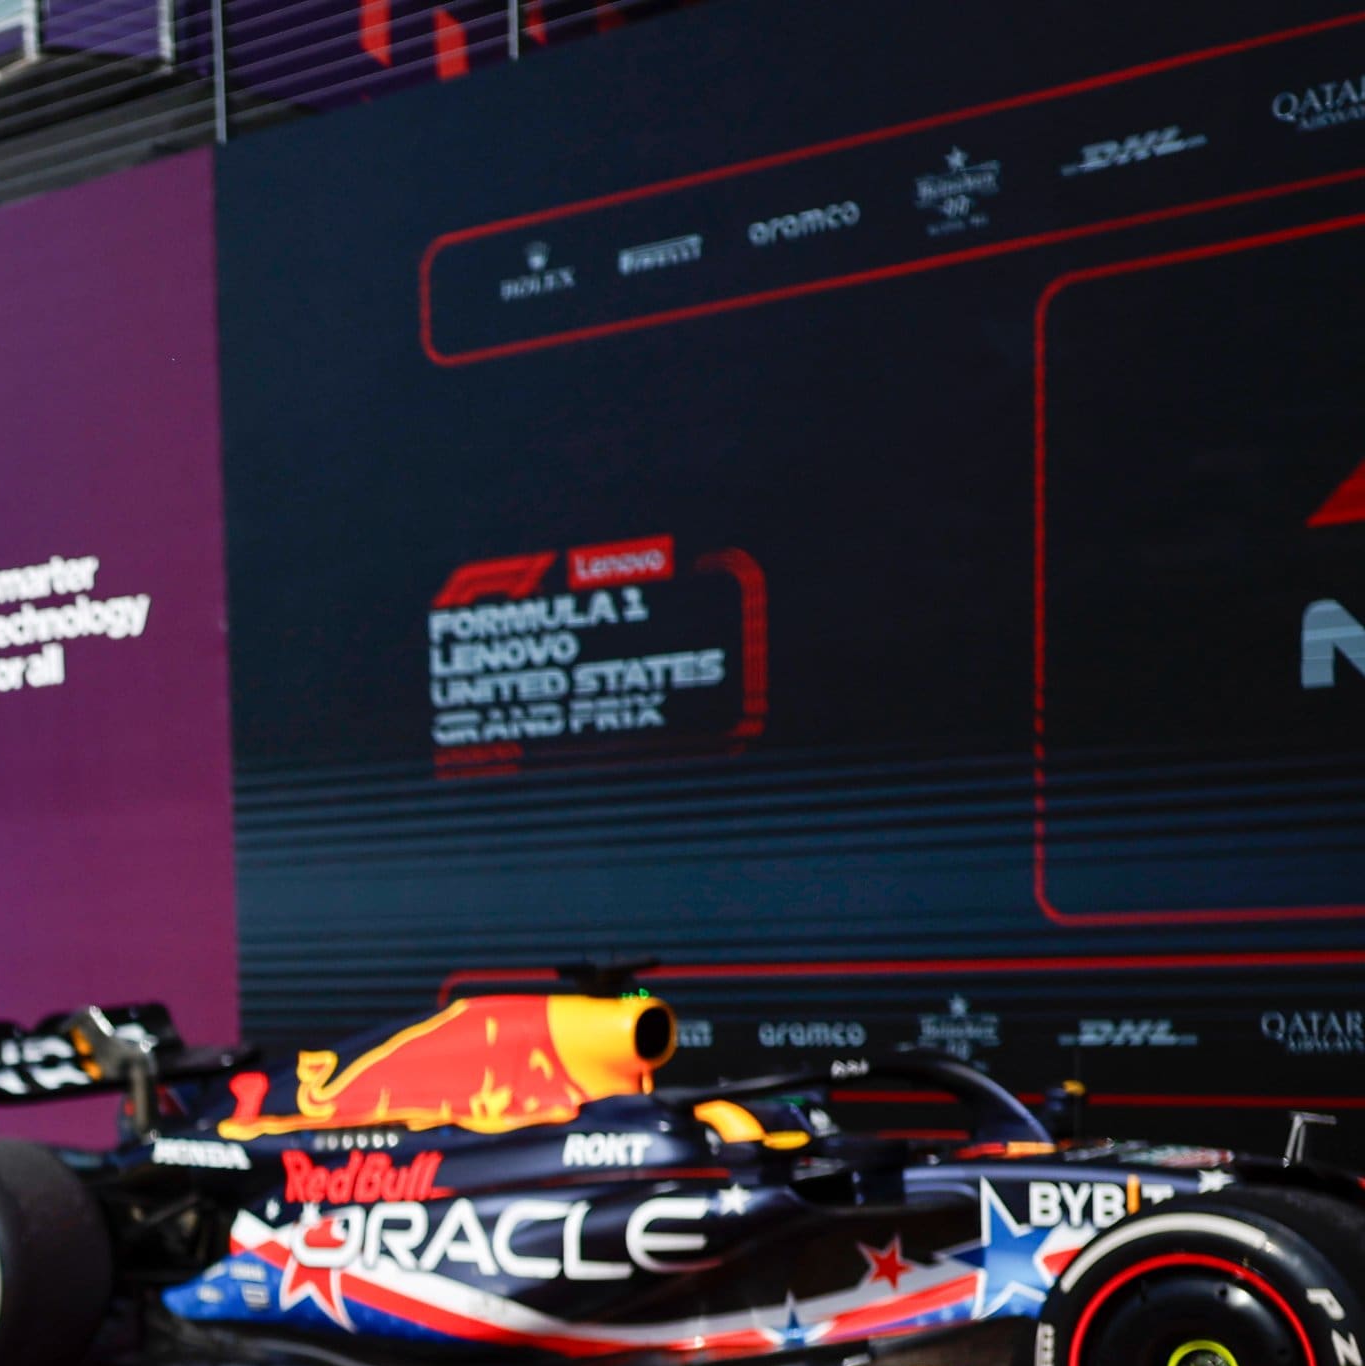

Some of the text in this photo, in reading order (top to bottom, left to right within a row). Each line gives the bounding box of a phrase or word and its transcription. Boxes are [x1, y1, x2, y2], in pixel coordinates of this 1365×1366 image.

[748, 200, 861, 246] aramco
[576, 550, 665, 580] Lenovo
[429, 586, 649, 642] FORMULA 1
[25, 643, 65, 686] all
[430, 633, 579, 676] LENOVO
[431, 649, 725, 707] UNITED STATES
[758, 1020, 866, 1047] aramco
[1261, 1010, 1365, 1041] QATAR
[563, 1132, 648, 1165] ROKT
[290, 1196, 711, 1281] ORACLE
[1305, 1287, 1346, 1321] P
